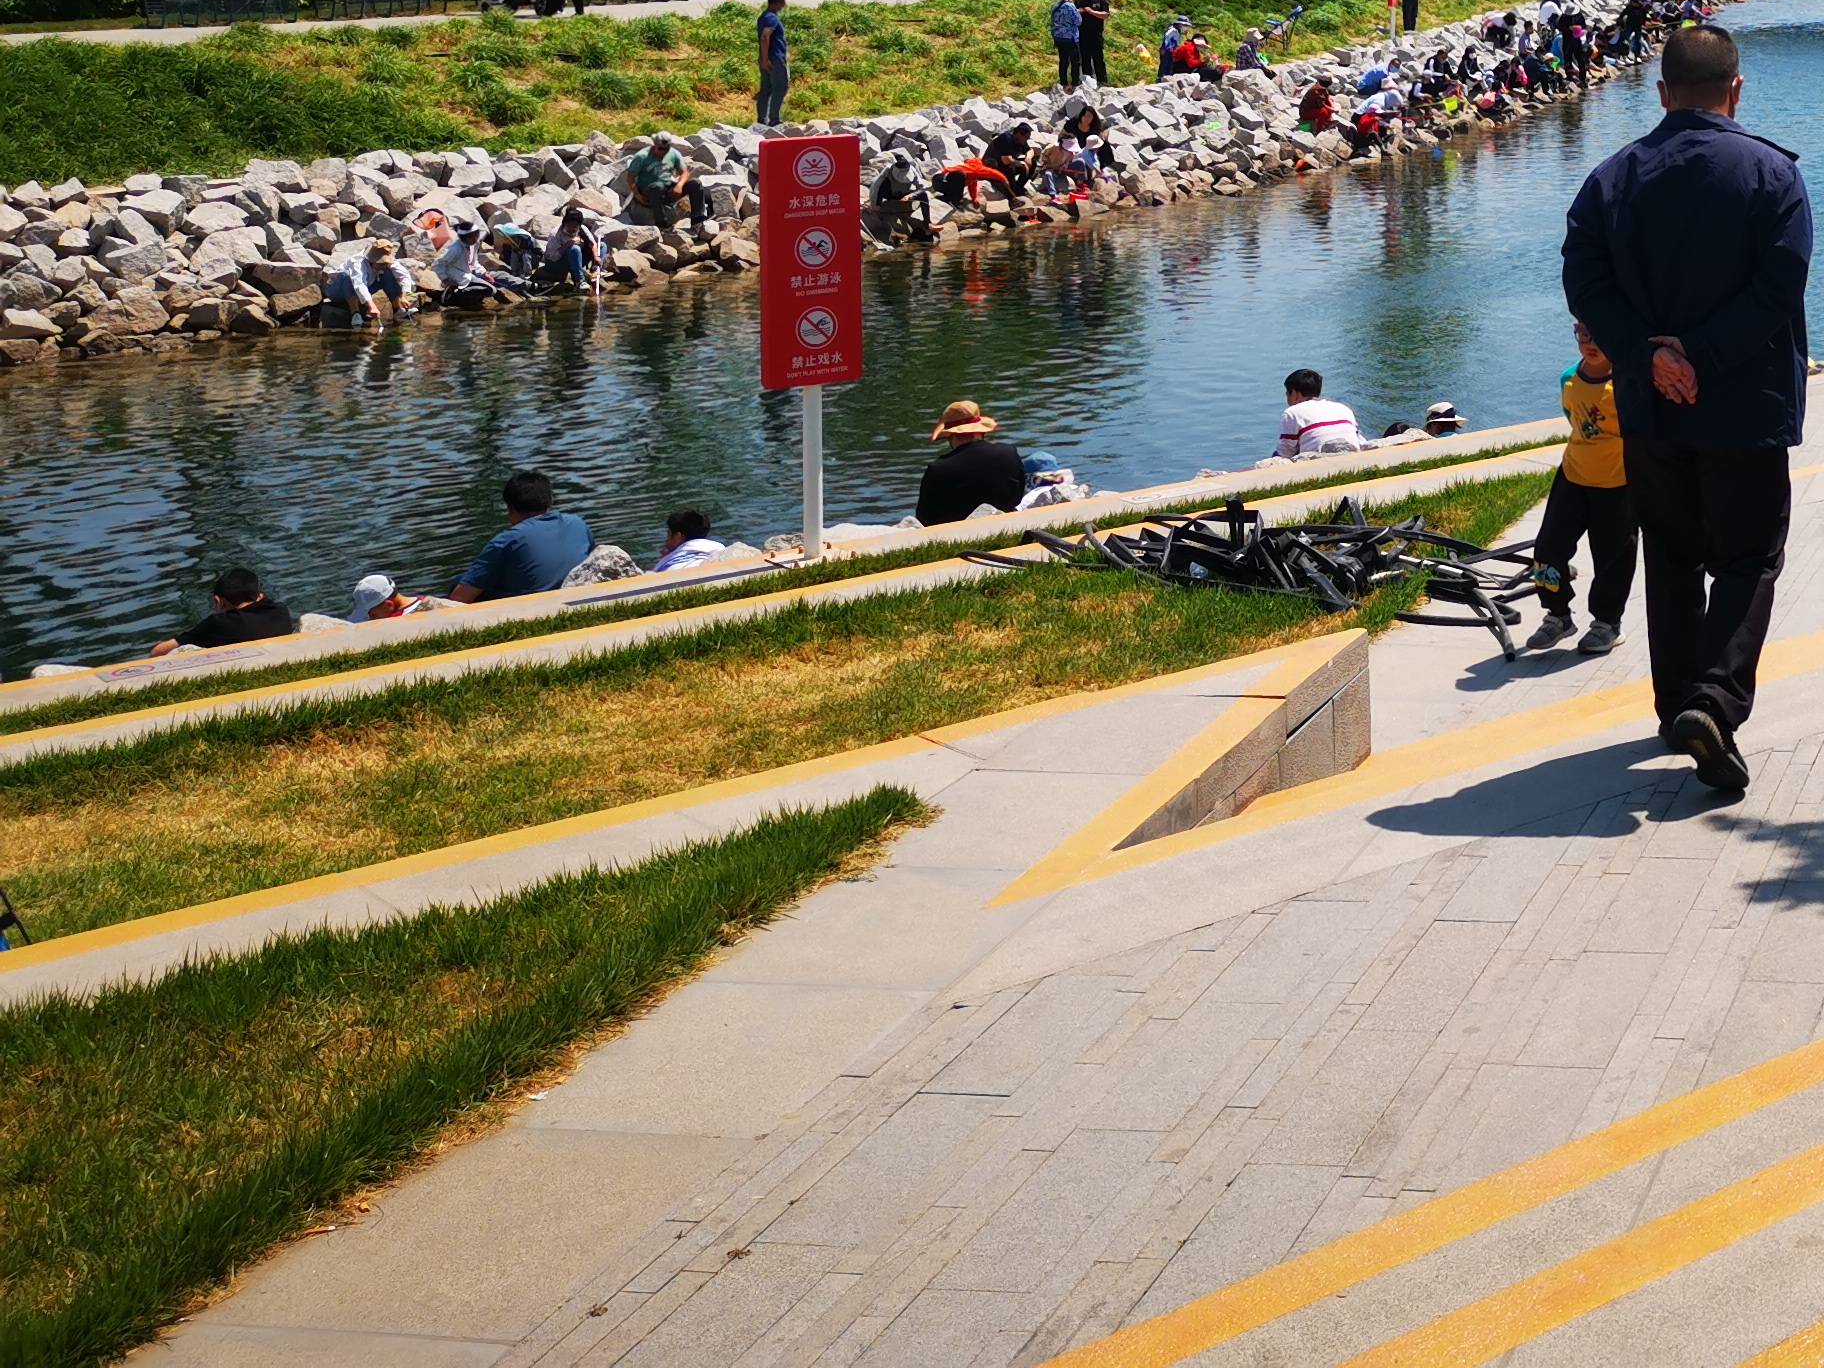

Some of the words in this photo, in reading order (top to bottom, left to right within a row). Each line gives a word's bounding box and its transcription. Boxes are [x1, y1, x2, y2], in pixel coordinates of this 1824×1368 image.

[789, 193, 841, 209] 水深危险
[790, 271, 842, 288] 禁止游泳
[791, 351, 844, 369] 禁止戏水
